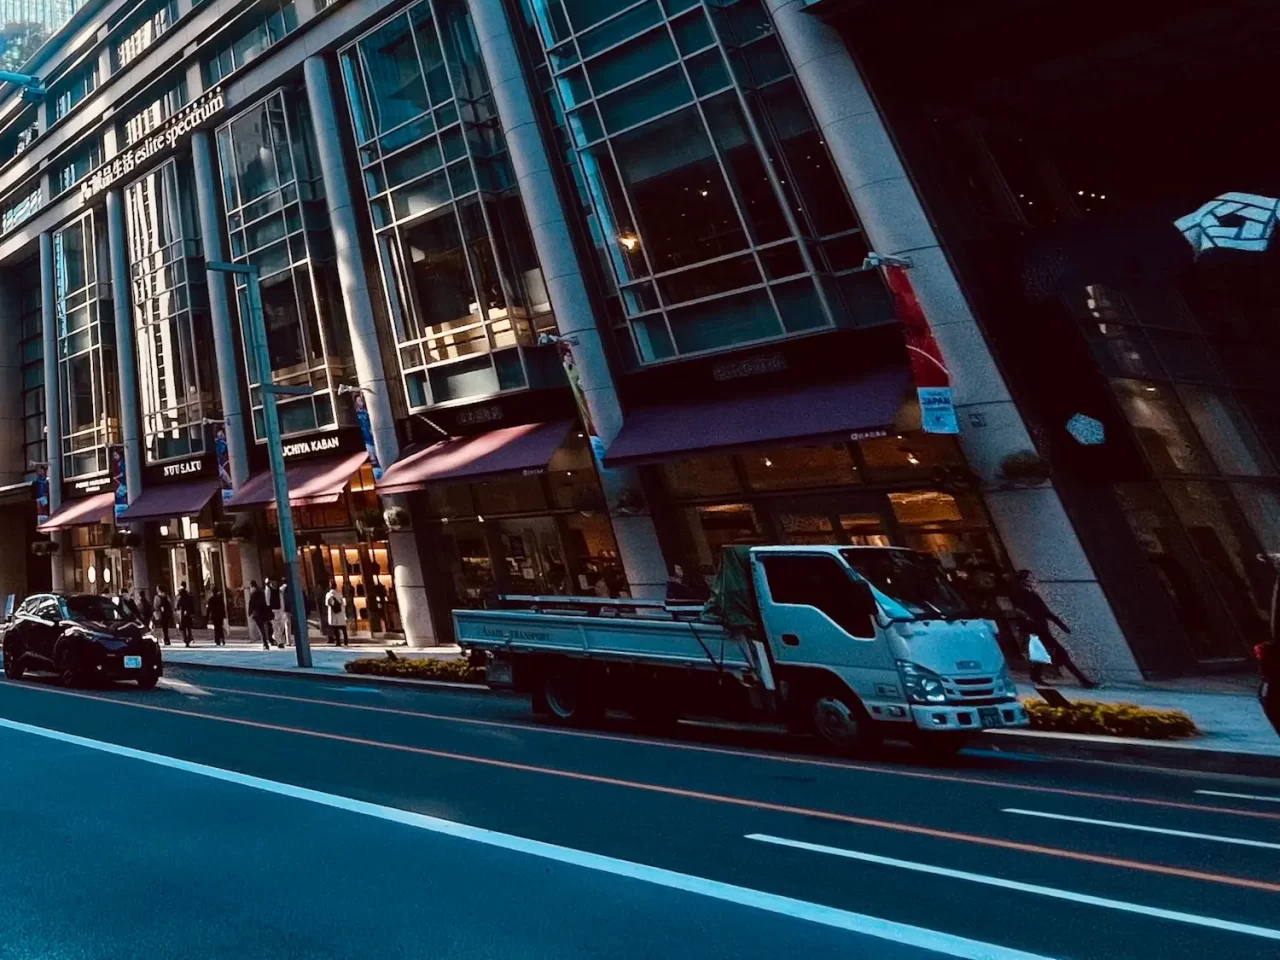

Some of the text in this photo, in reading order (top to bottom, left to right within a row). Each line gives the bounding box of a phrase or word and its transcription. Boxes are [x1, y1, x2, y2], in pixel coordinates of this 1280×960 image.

[135, 135, 165, 165] eslite
[165, 95, 224, 149] spectrum
[311, 436, 339, 452] KABAN
